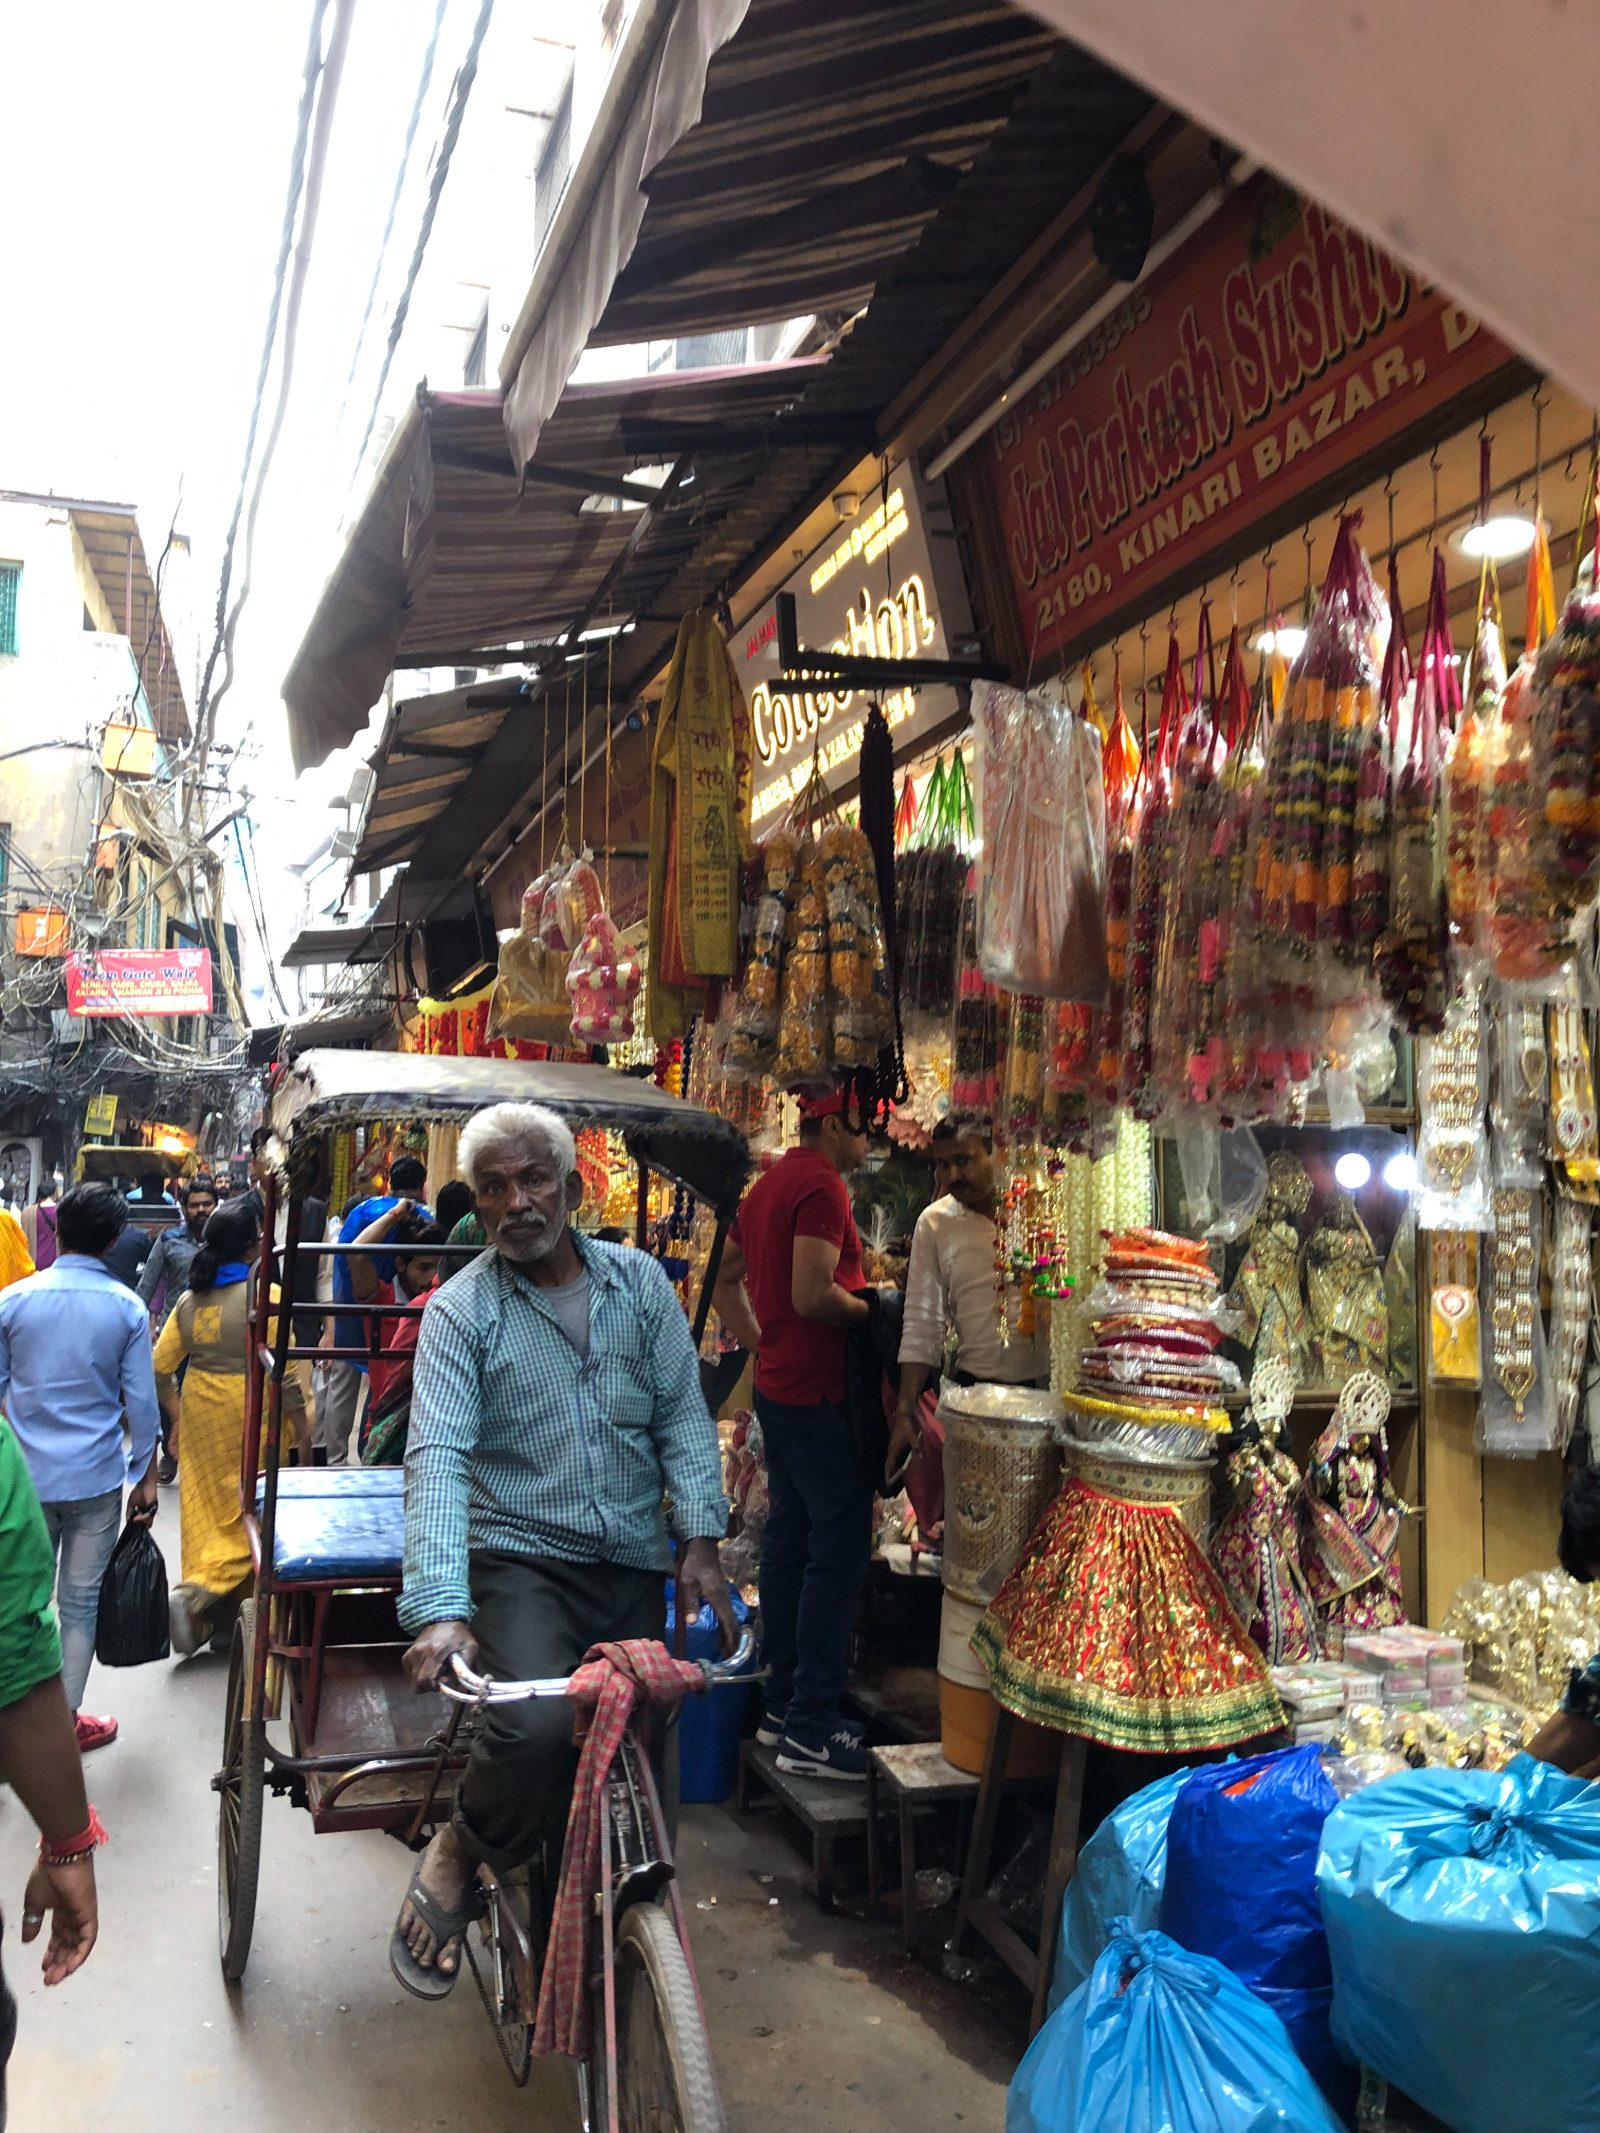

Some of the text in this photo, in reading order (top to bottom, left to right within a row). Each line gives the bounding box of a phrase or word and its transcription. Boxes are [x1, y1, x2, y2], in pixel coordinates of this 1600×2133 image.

[1037, 562, 1112, 631] 2180,
[1119, 460, 1243, 574] KINARI
[1252, 345, 1426, 482] BAZAR,
[1058, 304, 1236, 552] Parkash
